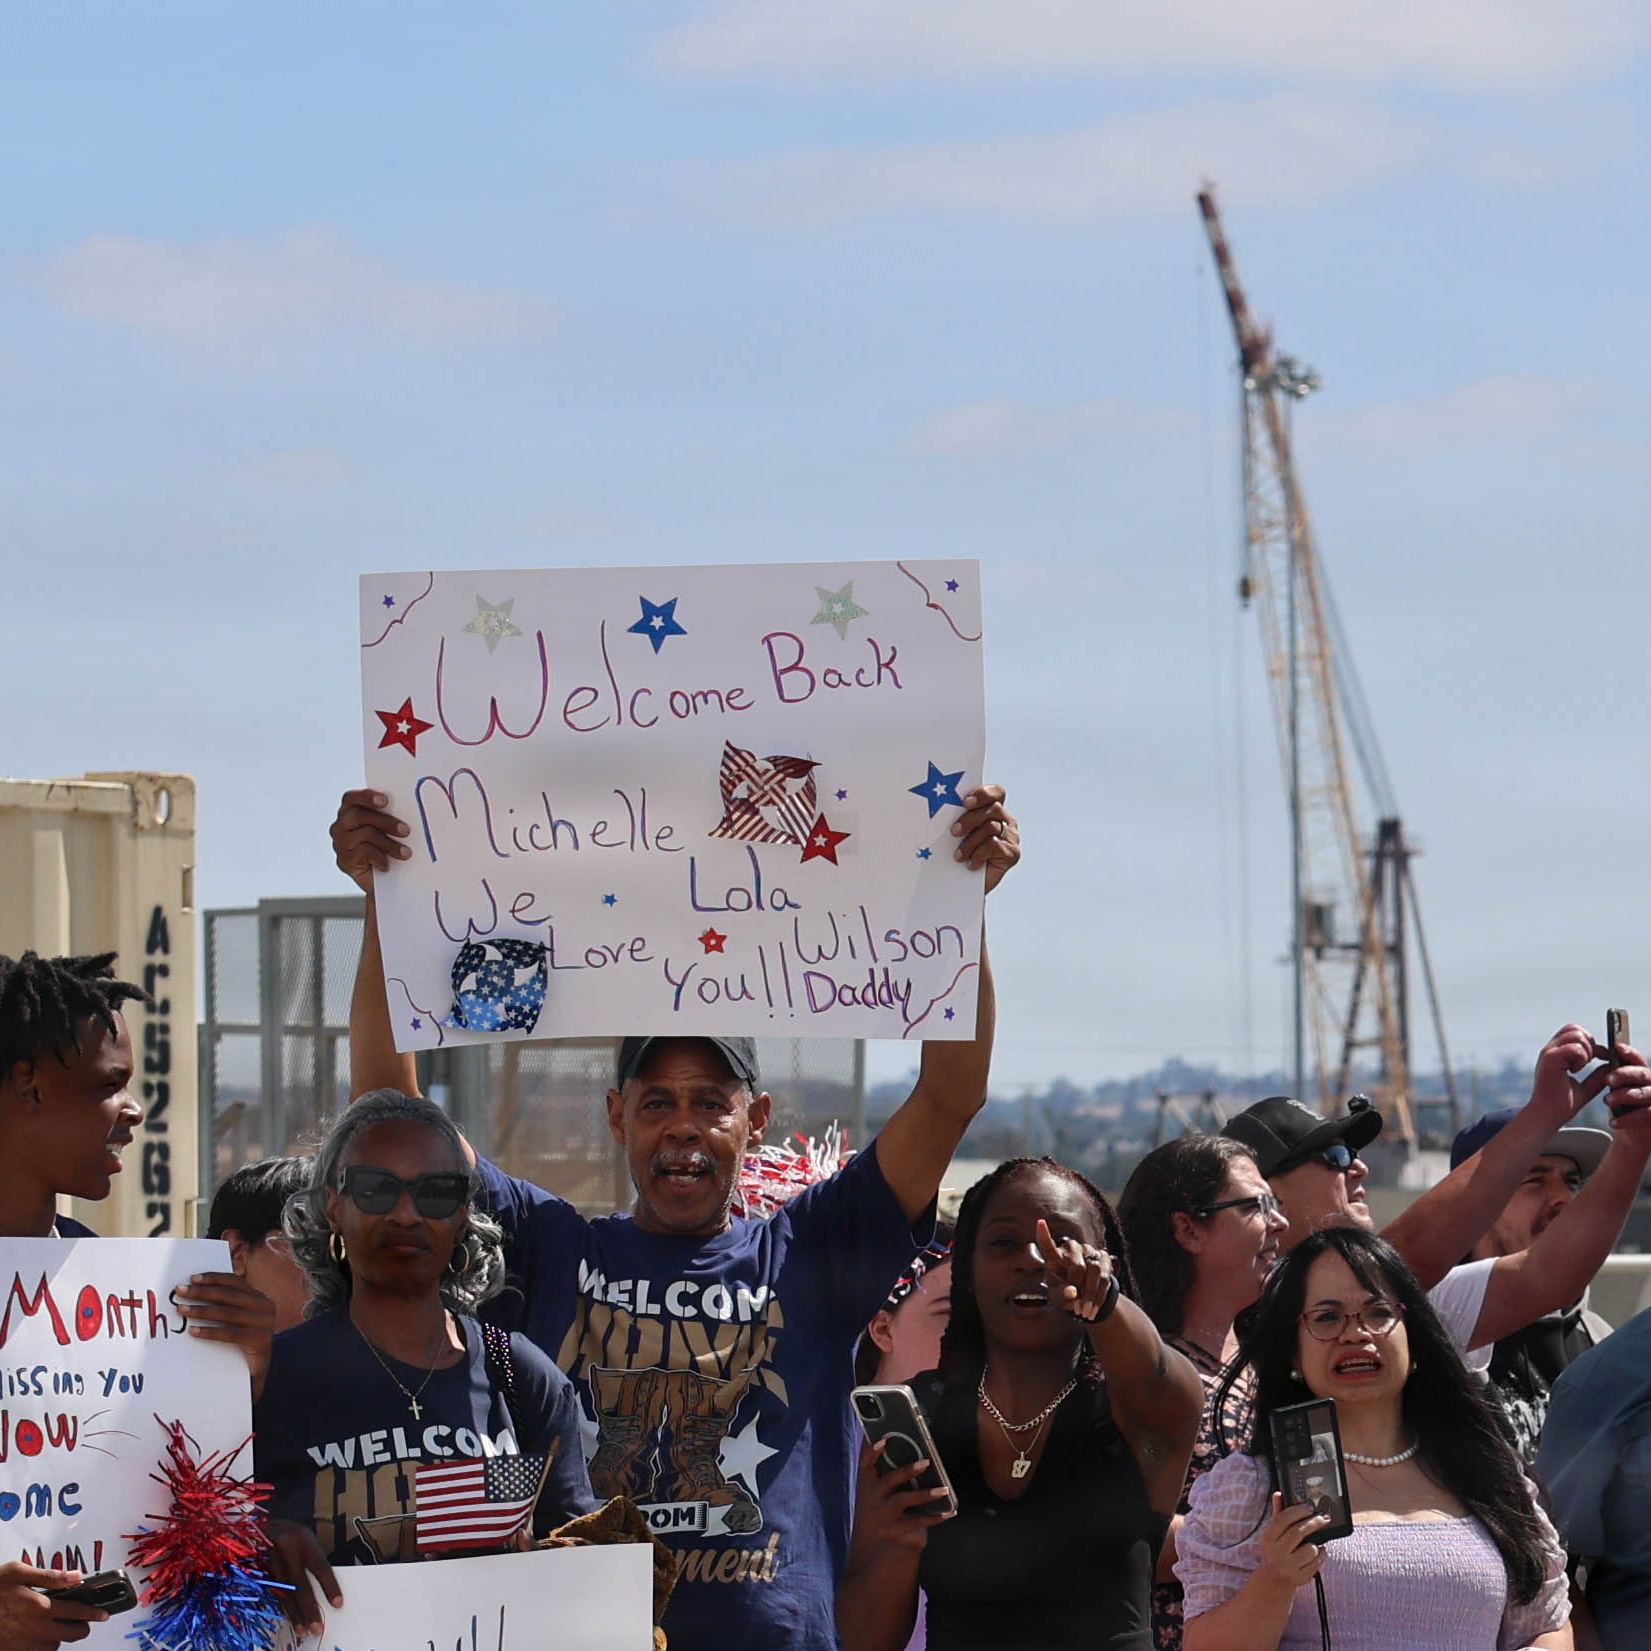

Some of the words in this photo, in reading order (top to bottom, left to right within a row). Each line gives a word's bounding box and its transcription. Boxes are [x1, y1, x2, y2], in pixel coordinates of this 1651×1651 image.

[435, 620, 755, 747] Welcome
[761, 632, 903, 704] Back
[415, 767, 685, 863] Michelle
[689, 845, 800, 913] Lola
[793, 906, 965, 966] Wilson
[433, 878, 553, 943] We
[548, 924, 655, 971] Love
[801, 967, 913, 1025] Daddy
[578, 1258, 777, 1321] WELCOM
[307, 1425, 511, 1468] WELCOM
[640, 1509, 696, 1529] OM
